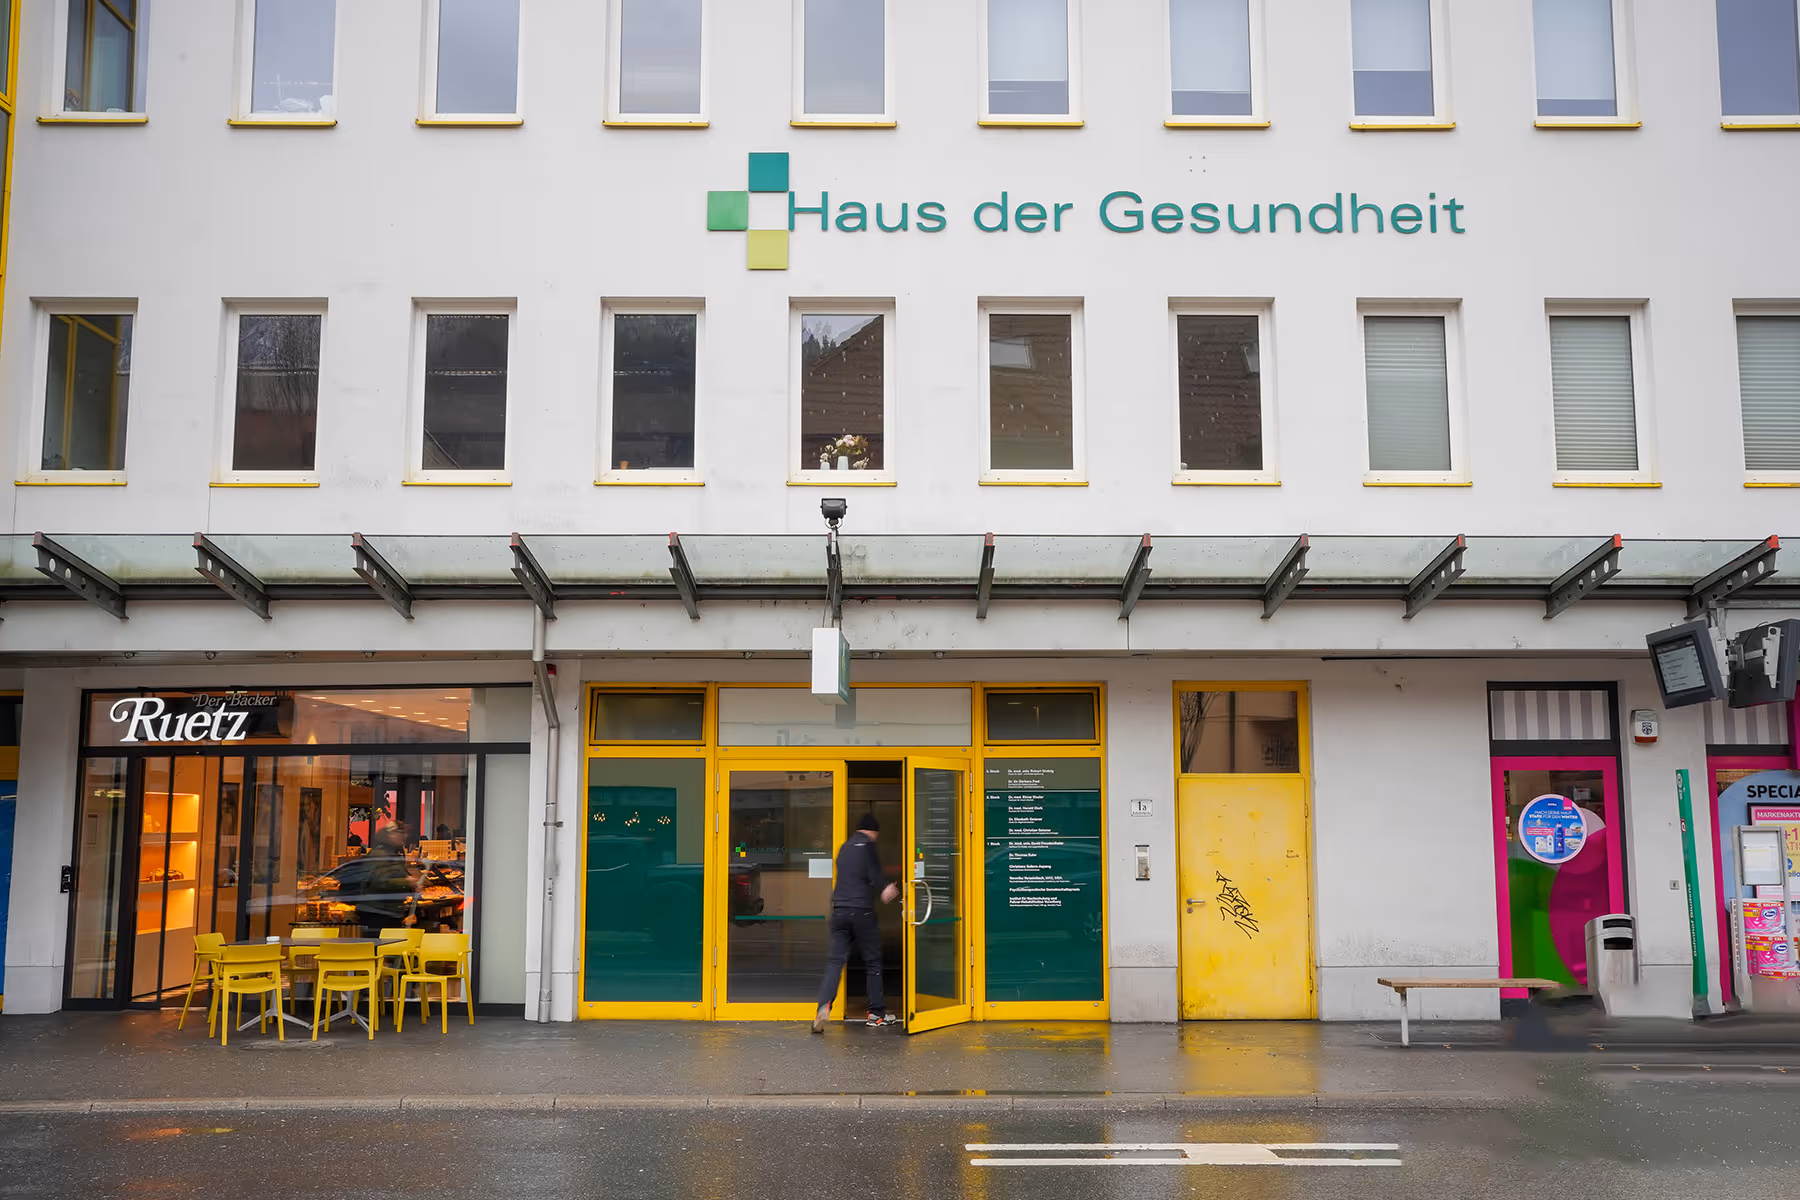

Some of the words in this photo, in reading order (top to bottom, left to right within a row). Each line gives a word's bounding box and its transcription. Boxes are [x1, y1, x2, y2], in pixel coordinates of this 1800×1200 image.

[788, 190, 947, 234] Haus
[973, 190, 1074, 234] der
[1099, 190, 1466, 234] Gesundheit
[109, 697, 249, 742] Ruetz
[191, 693, 224, 707] Der
[225, 692, 277, 707] Bäcker
